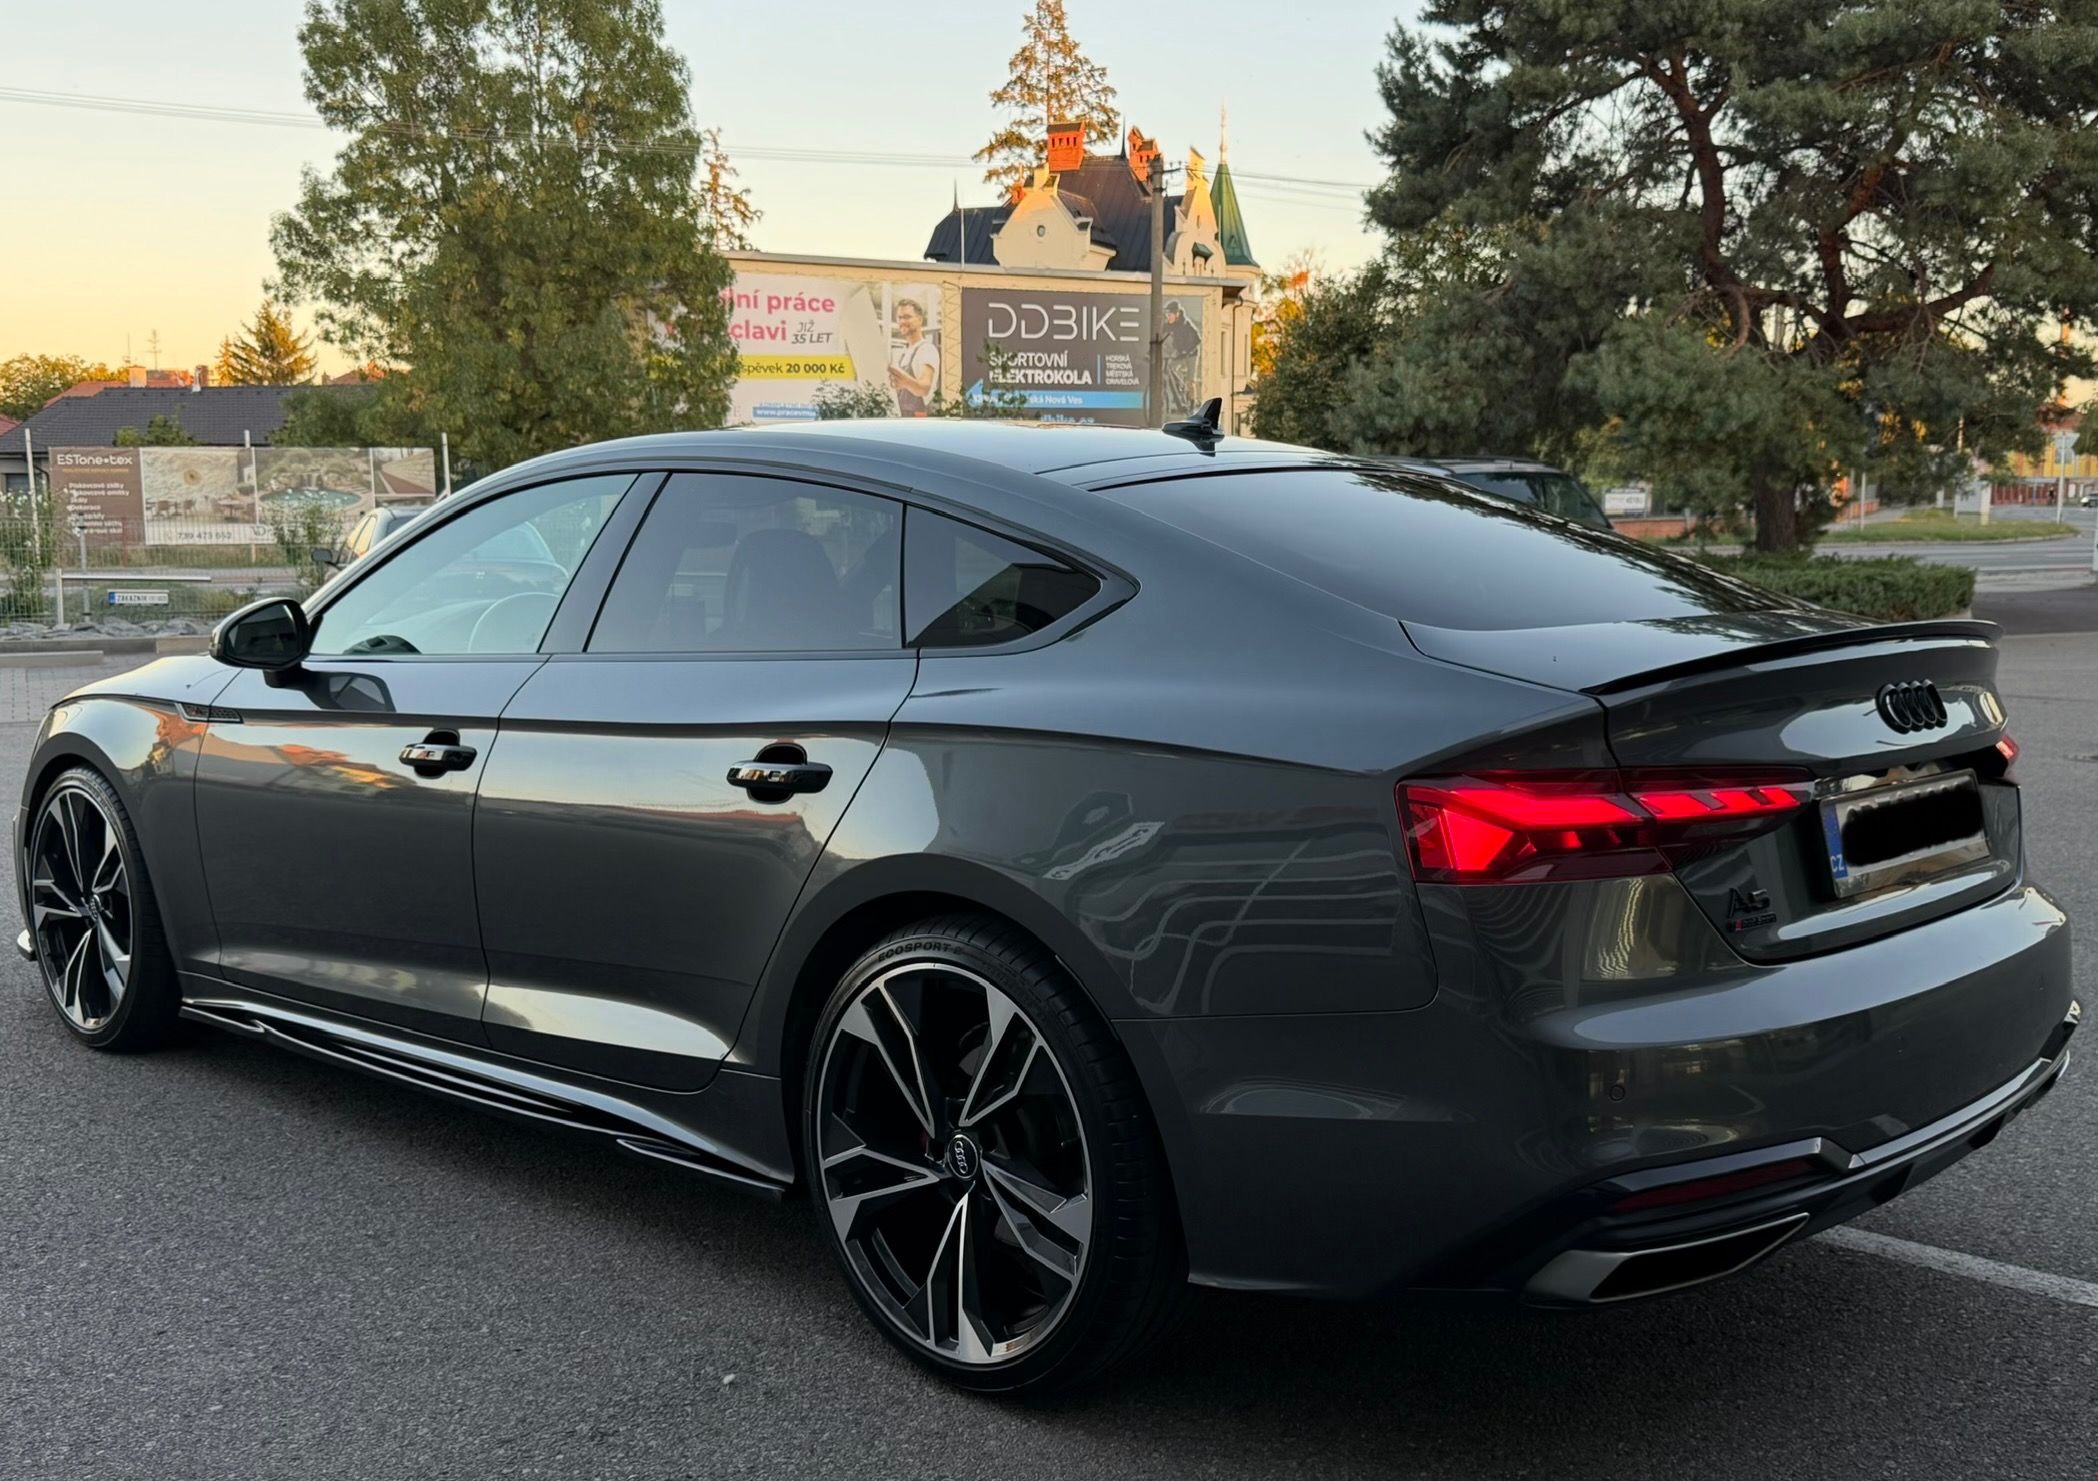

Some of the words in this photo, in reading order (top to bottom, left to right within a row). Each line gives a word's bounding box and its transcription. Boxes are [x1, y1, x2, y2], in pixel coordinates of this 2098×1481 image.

[767, 291, 835, 314] práce
[730, 319, 787, 341] clavi
[987, 302, 1140, 342] DDBIKE
[791, 333, 807, 345] 35
[809, 333, 833, 344] LET
[785, 362, 801, 374] 20
[804, 363, 827, 374] 000
[830, 362, 845, 374] Kč
[988, 350, 1068, 368] SPORTOVNÍ
[988, 368, 1093, 385] ELEKTROKOLA
[1045, 394, 1067, 404] Nová
[1068, 395, 1084, 405] Ves
[1830, 853, 1845, 873] CZ
[1727, 887, 1771, 919] A5
[877, 941, 952, 963] ECOSPORT
